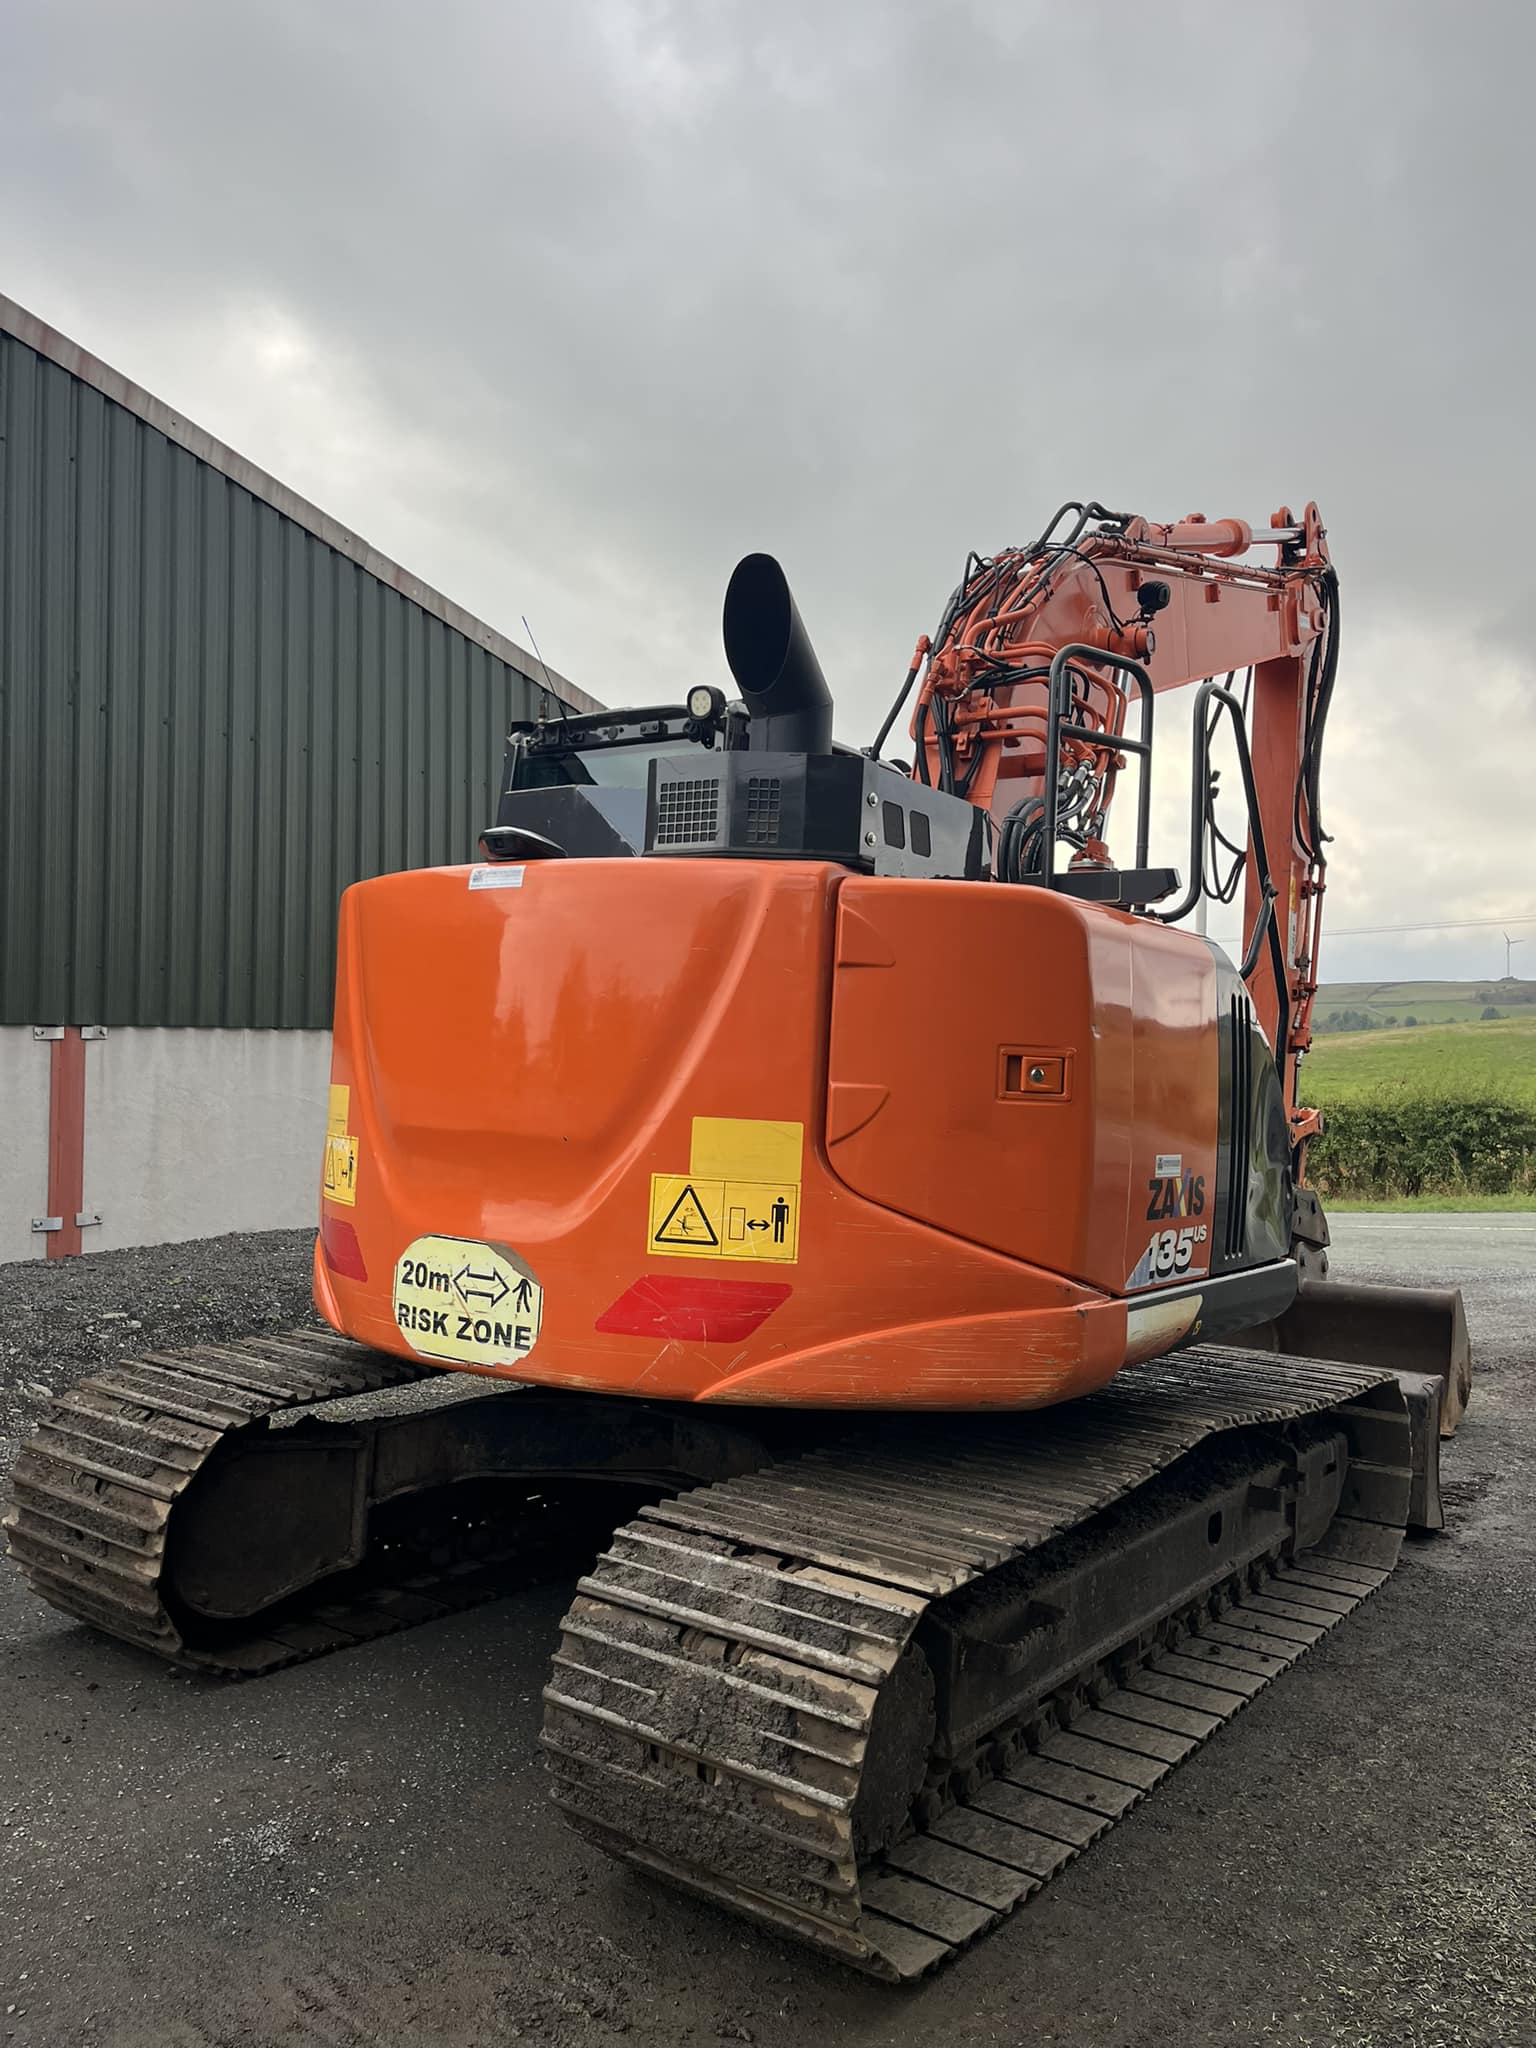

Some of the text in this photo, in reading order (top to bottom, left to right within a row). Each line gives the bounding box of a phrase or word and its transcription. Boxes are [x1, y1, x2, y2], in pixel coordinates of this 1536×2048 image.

[1146, 1168, 1205, 1221] ZAXIS
[401, 1260, 449, 1293] 20m
[398, 1303, 531, 1351] RISK ZONE
